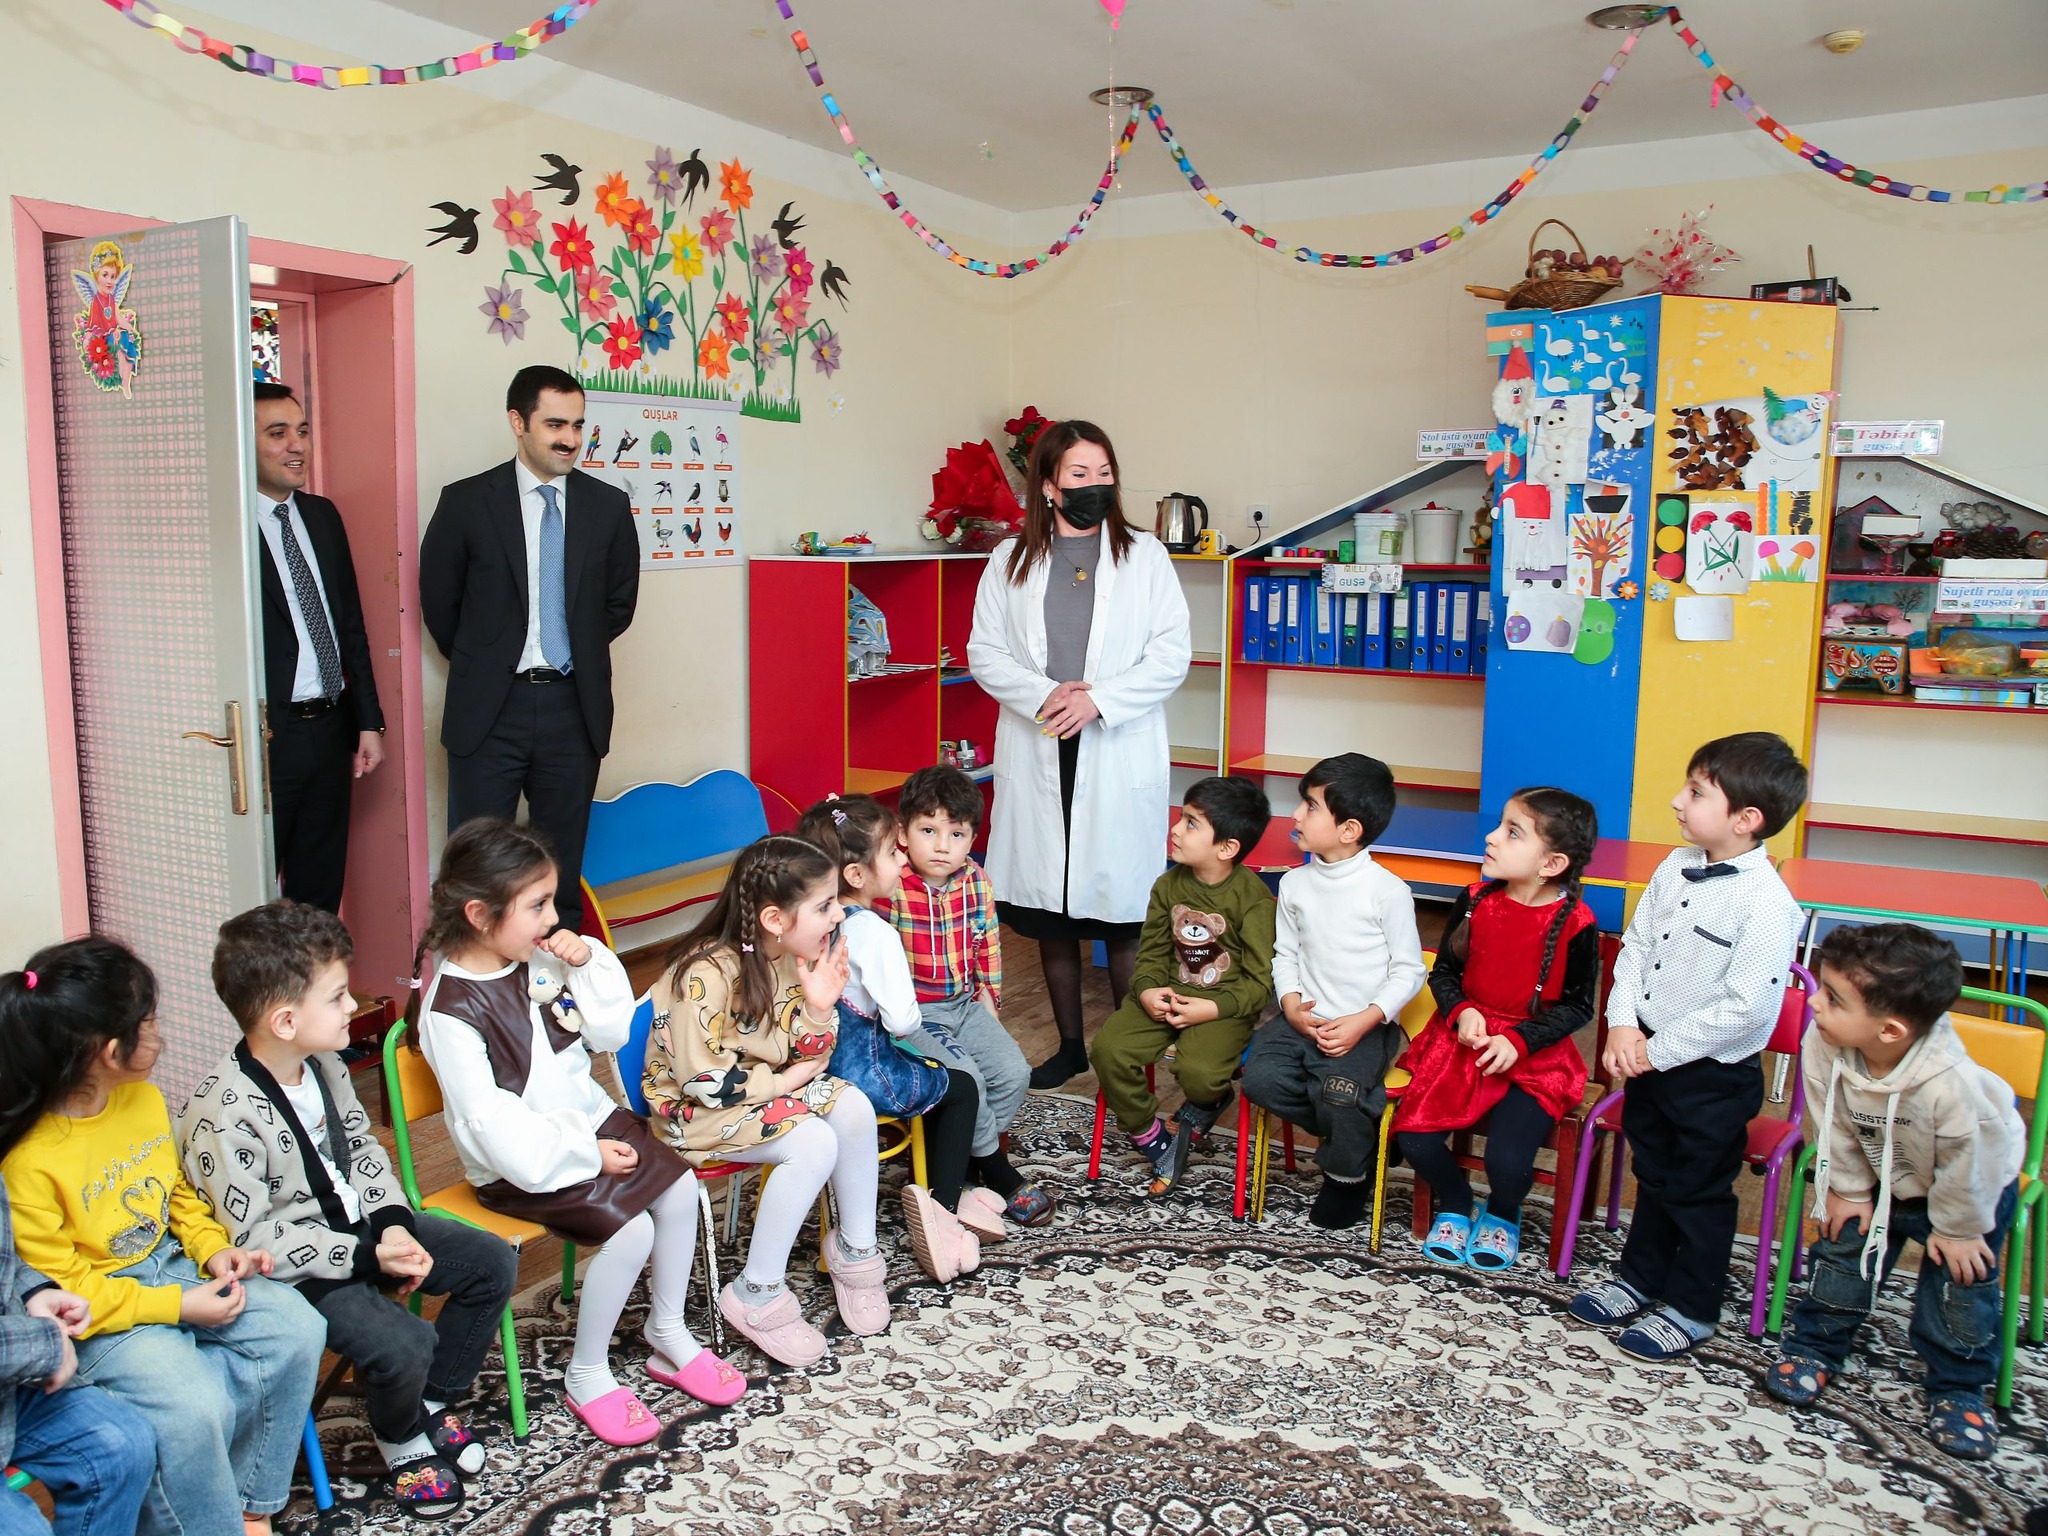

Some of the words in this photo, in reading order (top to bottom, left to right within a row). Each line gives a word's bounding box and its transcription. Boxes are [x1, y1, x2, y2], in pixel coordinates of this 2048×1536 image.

[642, 408, 678, 422] QUŞLAR
[1421, 433, 1439, 441] Stol
[1441, 432, 1460, 441] üstü
[1943, 586, 1984, 598] Sujetli
[1987, 587, 2013, 596] rolu
